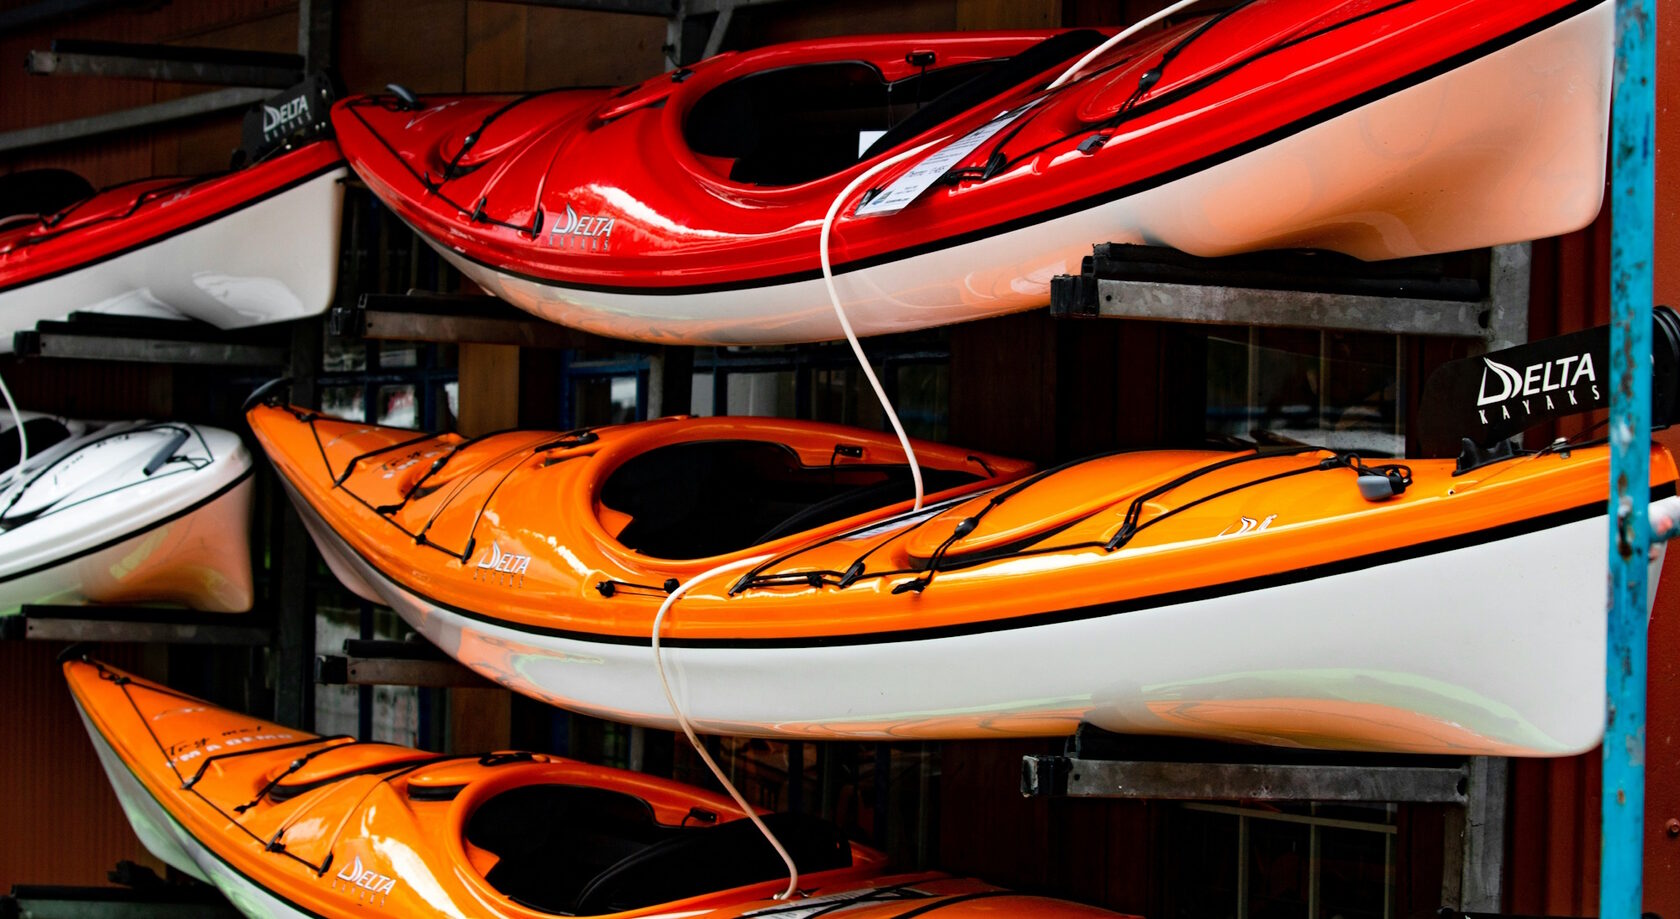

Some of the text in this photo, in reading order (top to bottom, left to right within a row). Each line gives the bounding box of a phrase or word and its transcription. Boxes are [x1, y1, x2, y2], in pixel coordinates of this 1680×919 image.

[263, 94, 309, 133] DELTA
[551, 203, 616, 238] DELTA
[1477, 352, 1596, 407] DELTA
[1478, 385, 1600, 425] KAYAKS
[477, 541, 532, 575] DELTA
[337, 854, 397, 896] DELTA
